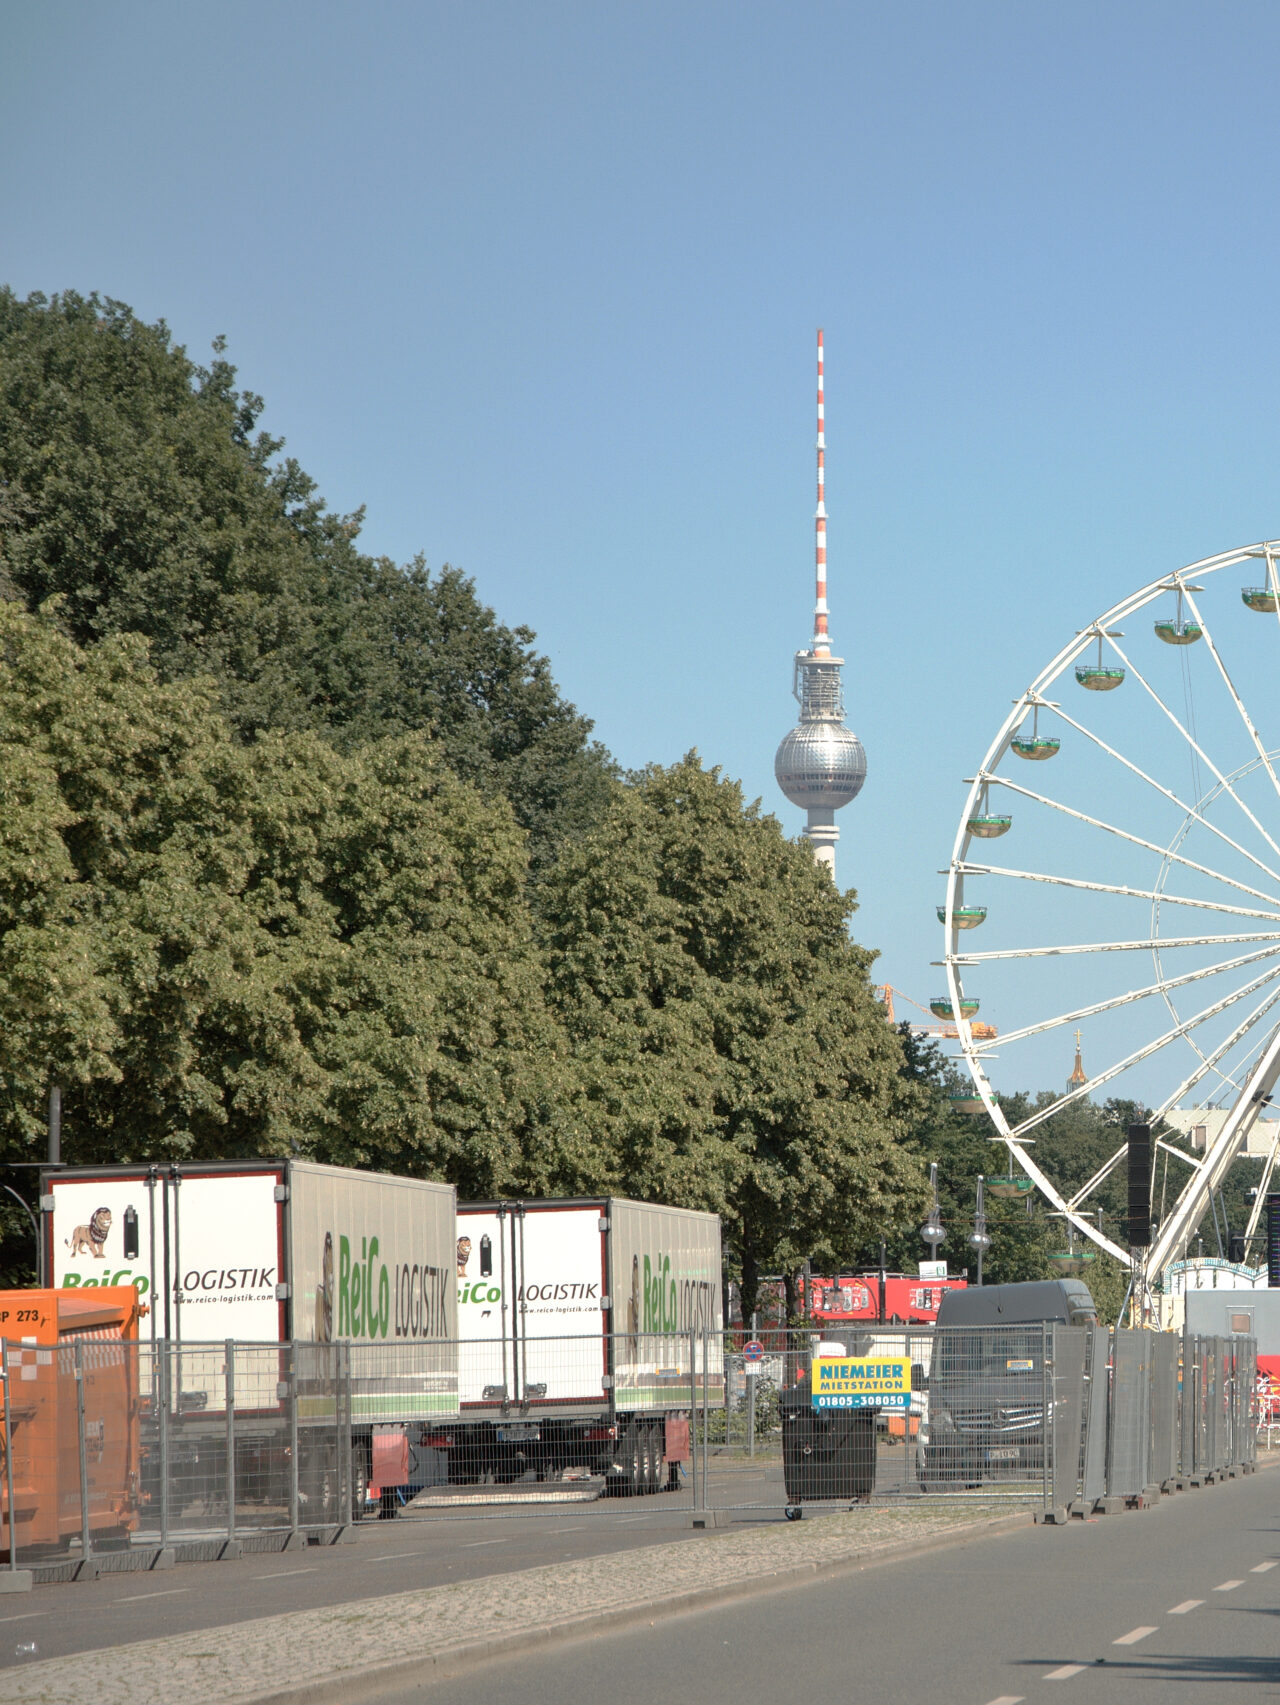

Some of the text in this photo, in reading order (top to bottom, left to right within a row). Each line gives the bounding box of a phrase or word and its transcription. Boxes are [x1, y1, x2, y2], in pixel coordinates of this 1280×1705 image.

[173, 1268, 276, 1292] LOGISTIK
[339, 1235, 449, 1339] ReiCo LOGISTIK
[517, 1283, 599, 1302] LOGISTIK
[643, 1252, 716, 1340] ReiCo LOGISTIK
[0, 1309, 39, 1323] P 273
[820, 1364, 904, 1379] NIEMEIER
[820, 1381, 903, 1390] MIETSTATION
